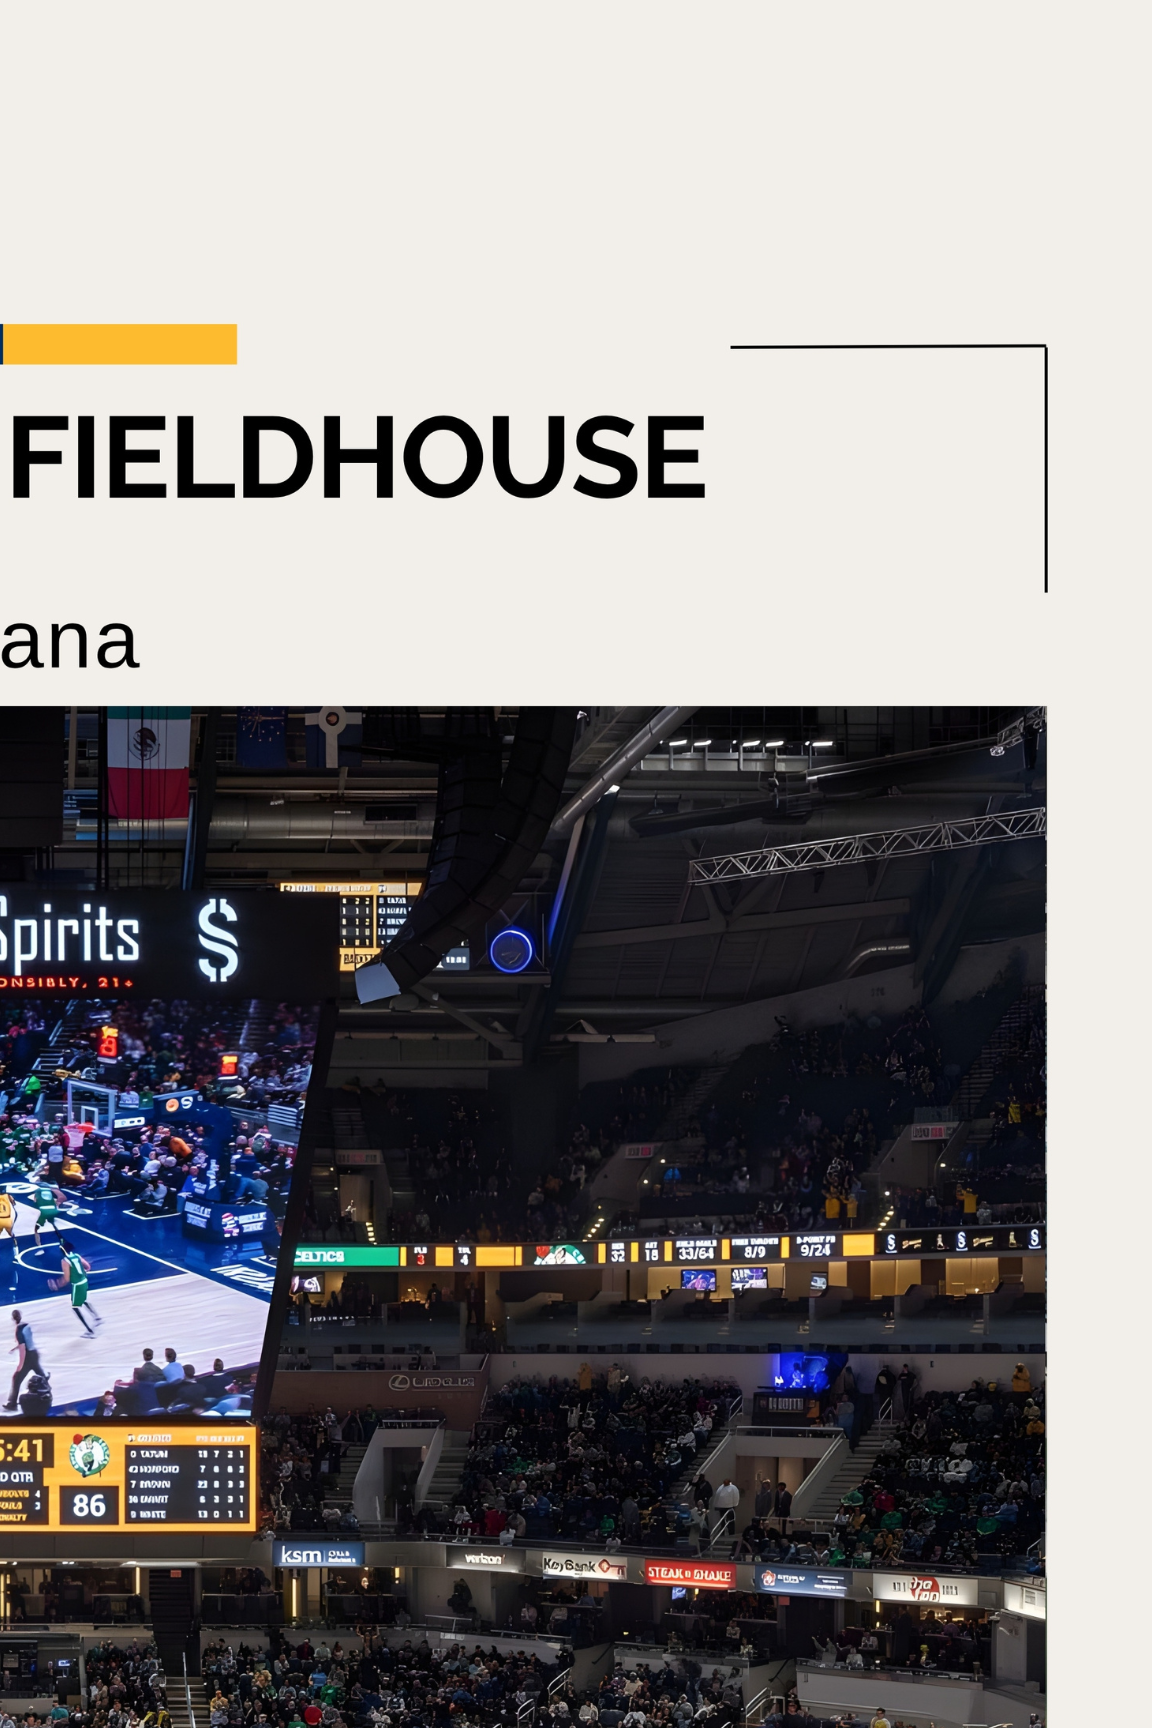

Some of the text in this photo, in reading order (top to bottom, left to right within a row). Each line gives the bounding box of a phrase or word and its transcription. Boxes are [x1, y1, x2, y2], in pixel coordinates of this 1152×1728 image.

[97, 977, 134, 989] 21+
[72, 1493, 107, 1518] 86
[280, 1545, 322, 1564] ksm
